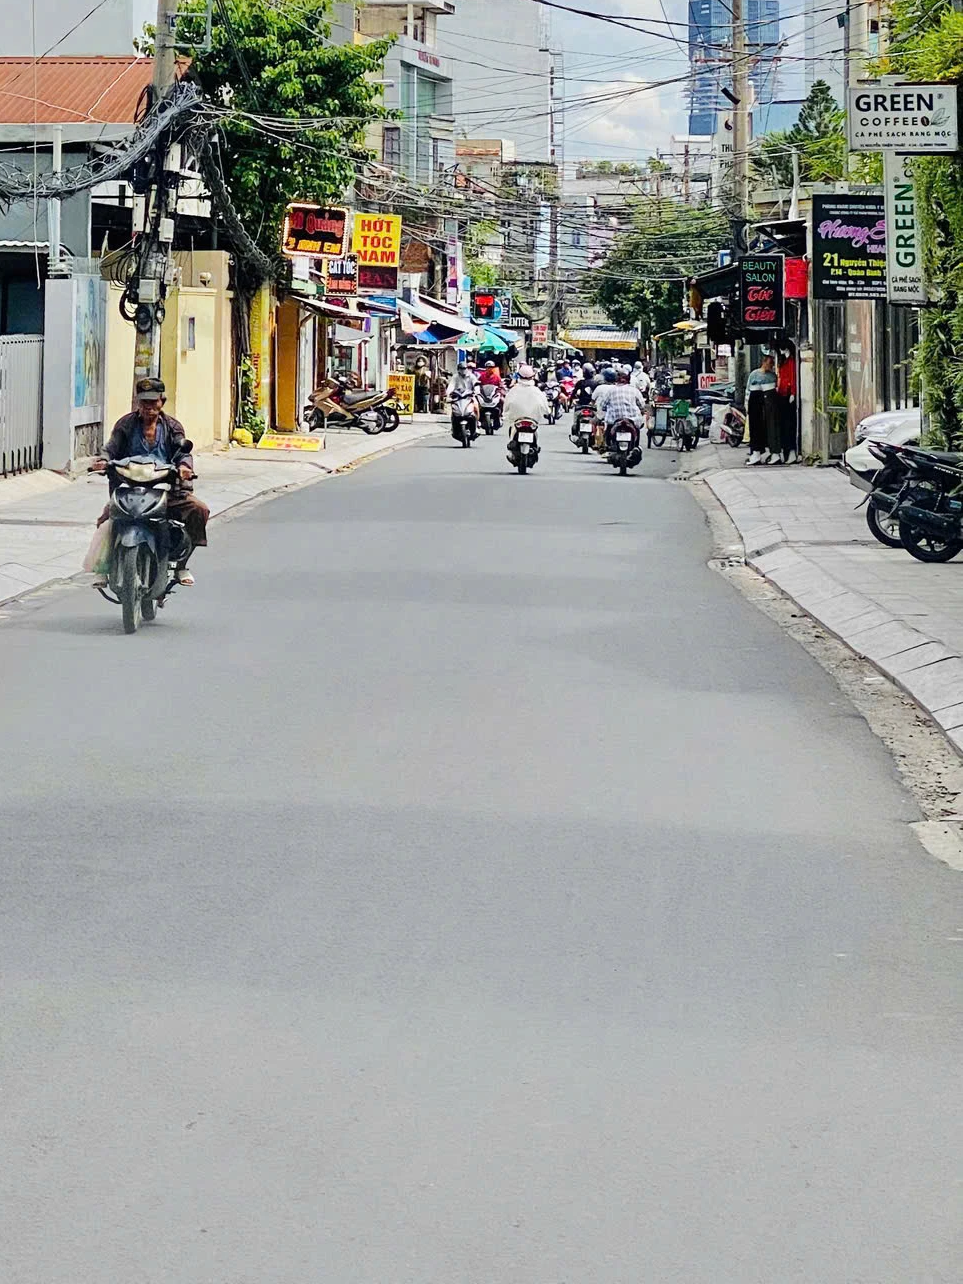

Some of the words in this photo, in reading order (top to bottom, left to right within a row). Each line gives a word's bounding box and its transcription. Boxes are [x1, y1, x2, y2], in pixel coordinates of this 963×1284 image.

[855, 93, 934, 113] GREEN
[860, 117, 919, 127] COFFEE
[360, 217, 394, 233] HỚT
[894, 183, 916, 268] GREEN
[360, 234, 393, 249] TÓC
[357, 249, 396, 264] NAM
[822, 252, 839, 267] 21
[742, 261, 776, 270] BEAUTY
[745, 273, 775, 282] SALON
